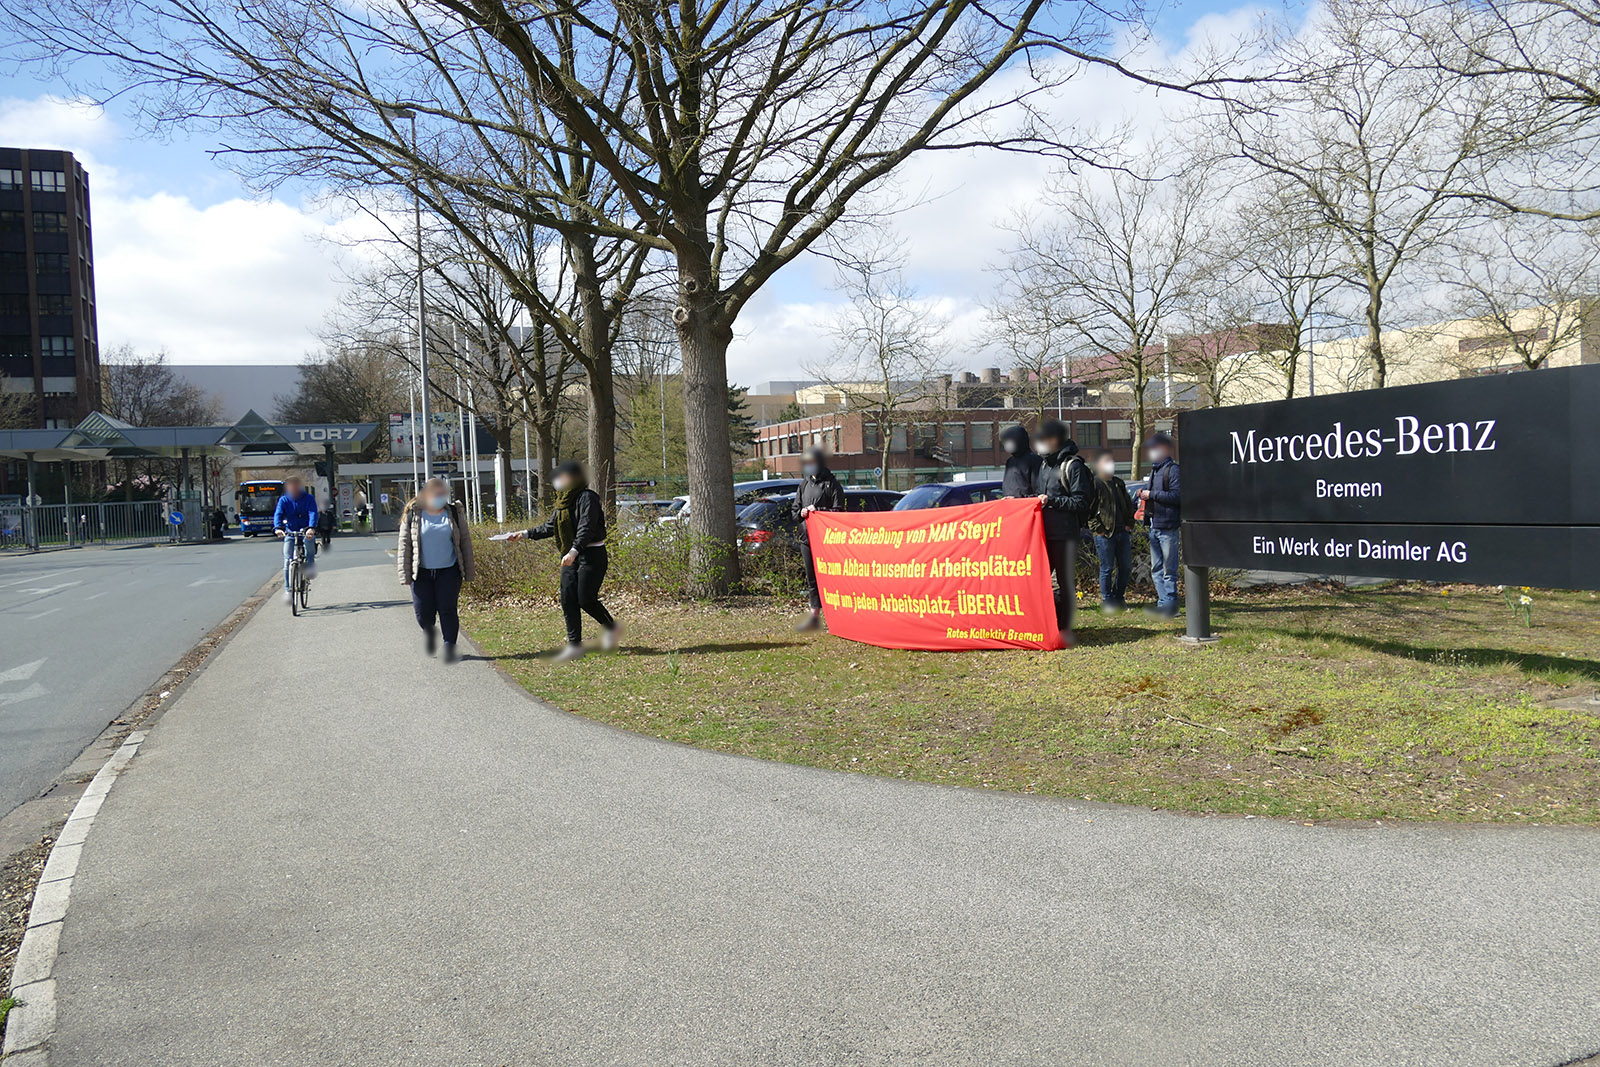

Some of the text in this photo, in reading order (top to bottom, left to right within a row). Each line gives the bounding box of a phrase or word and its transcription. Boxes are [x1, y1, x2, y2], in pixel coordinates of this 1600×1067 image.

[295, 428, 358, 441] TOR 7
[1229, 415, 1497, 465] Mercedes-Benz
[1316, 479, 1382, 498] Bremen
[823, 516, 1002, 548] Keine Schließung von MAN Steyr!
[1253, 537, 1467, 564] Ein Werk der Daimler AG
[827, 563, 842, 576] zum
[843, 559, 870, 577] Abbau
[871, 559, 926, 578] tausender
[929, 554, 1032, 580] Arbeitsplätze!
[841, 594, 852, 608] um
[853, 592, 878, 613] jeden
[880, 594, 955, 618] Arbeitsplatz,
[957, 591, 1025, 616] ÜBERALL
[946, 628, 1044, 642] Rotes Kollektiv Bremen
